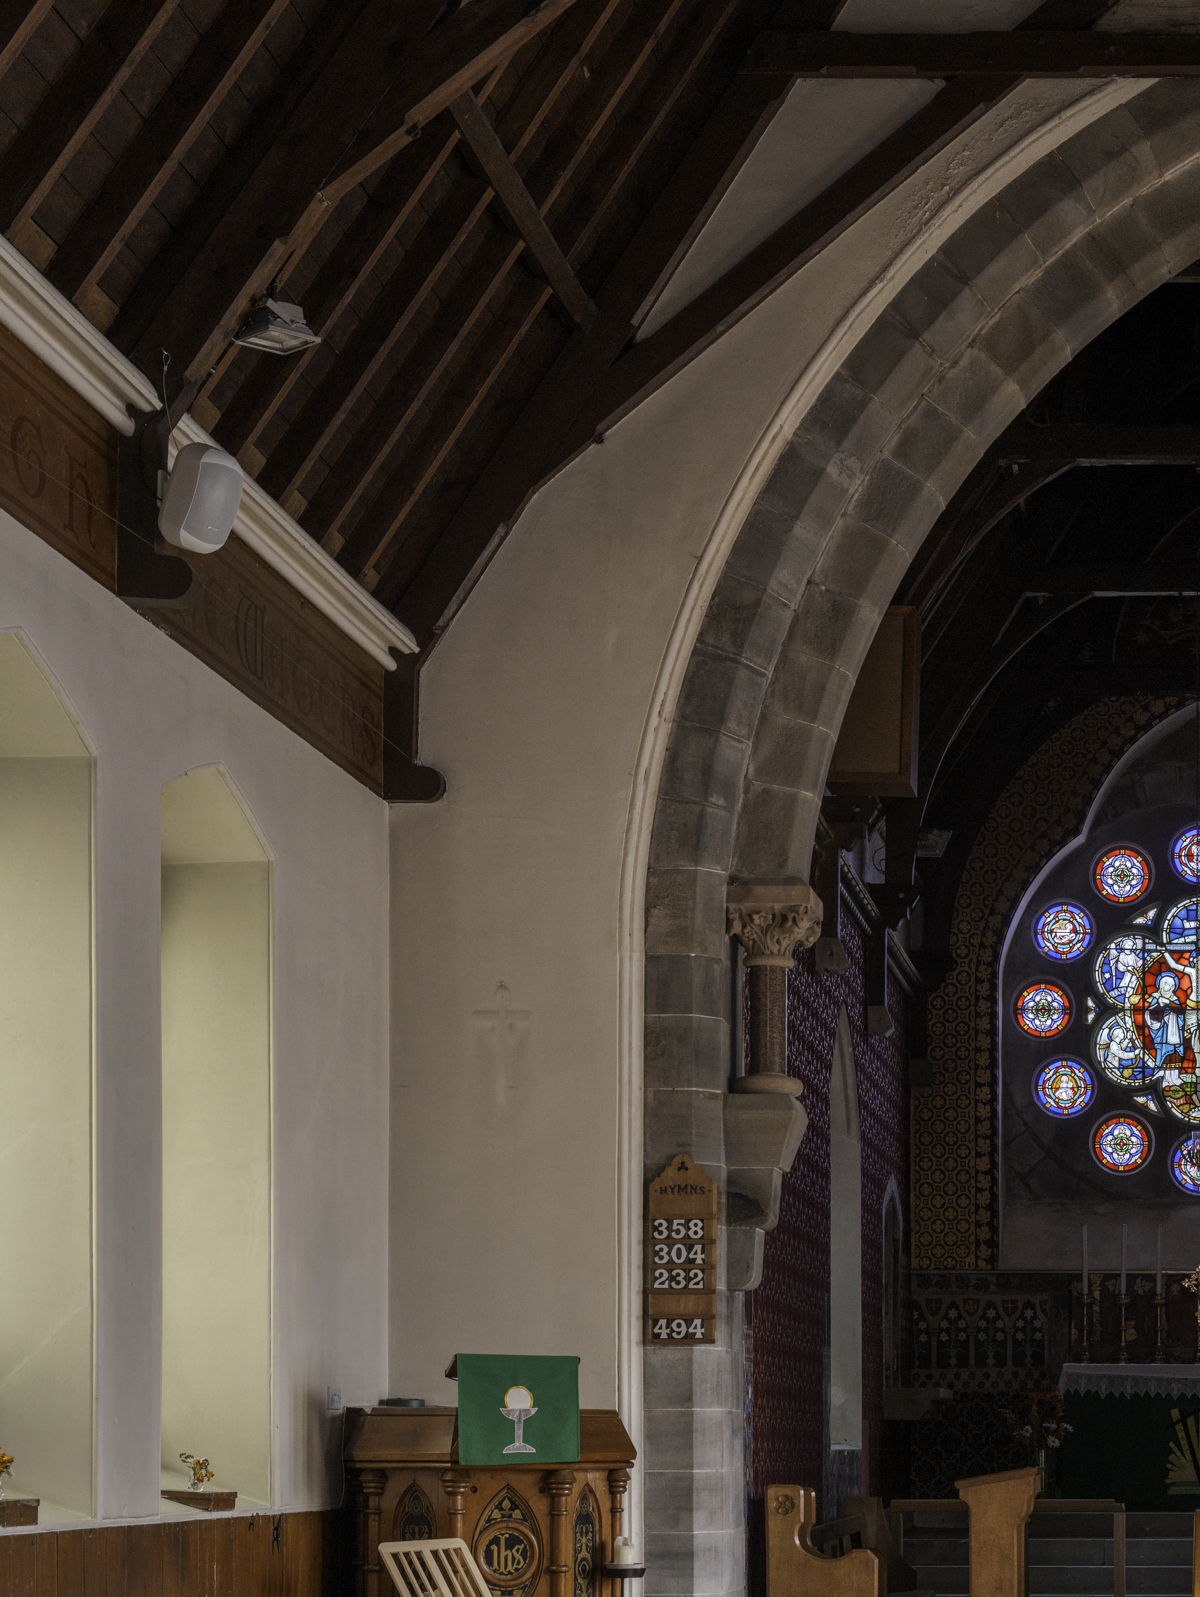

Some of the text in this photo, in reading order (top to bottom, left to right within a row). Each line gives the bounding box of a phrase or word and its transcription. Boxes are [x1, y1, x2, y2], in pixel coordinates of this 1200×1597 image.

[659, 1184, 706, 1195] HYMNS
[653, 1219, 704, 1239] 358
[653, 1244, 705, 1264] 304
[653, 1269, 704, 1289] 232
[653, 1318, 704, 1339] 494
